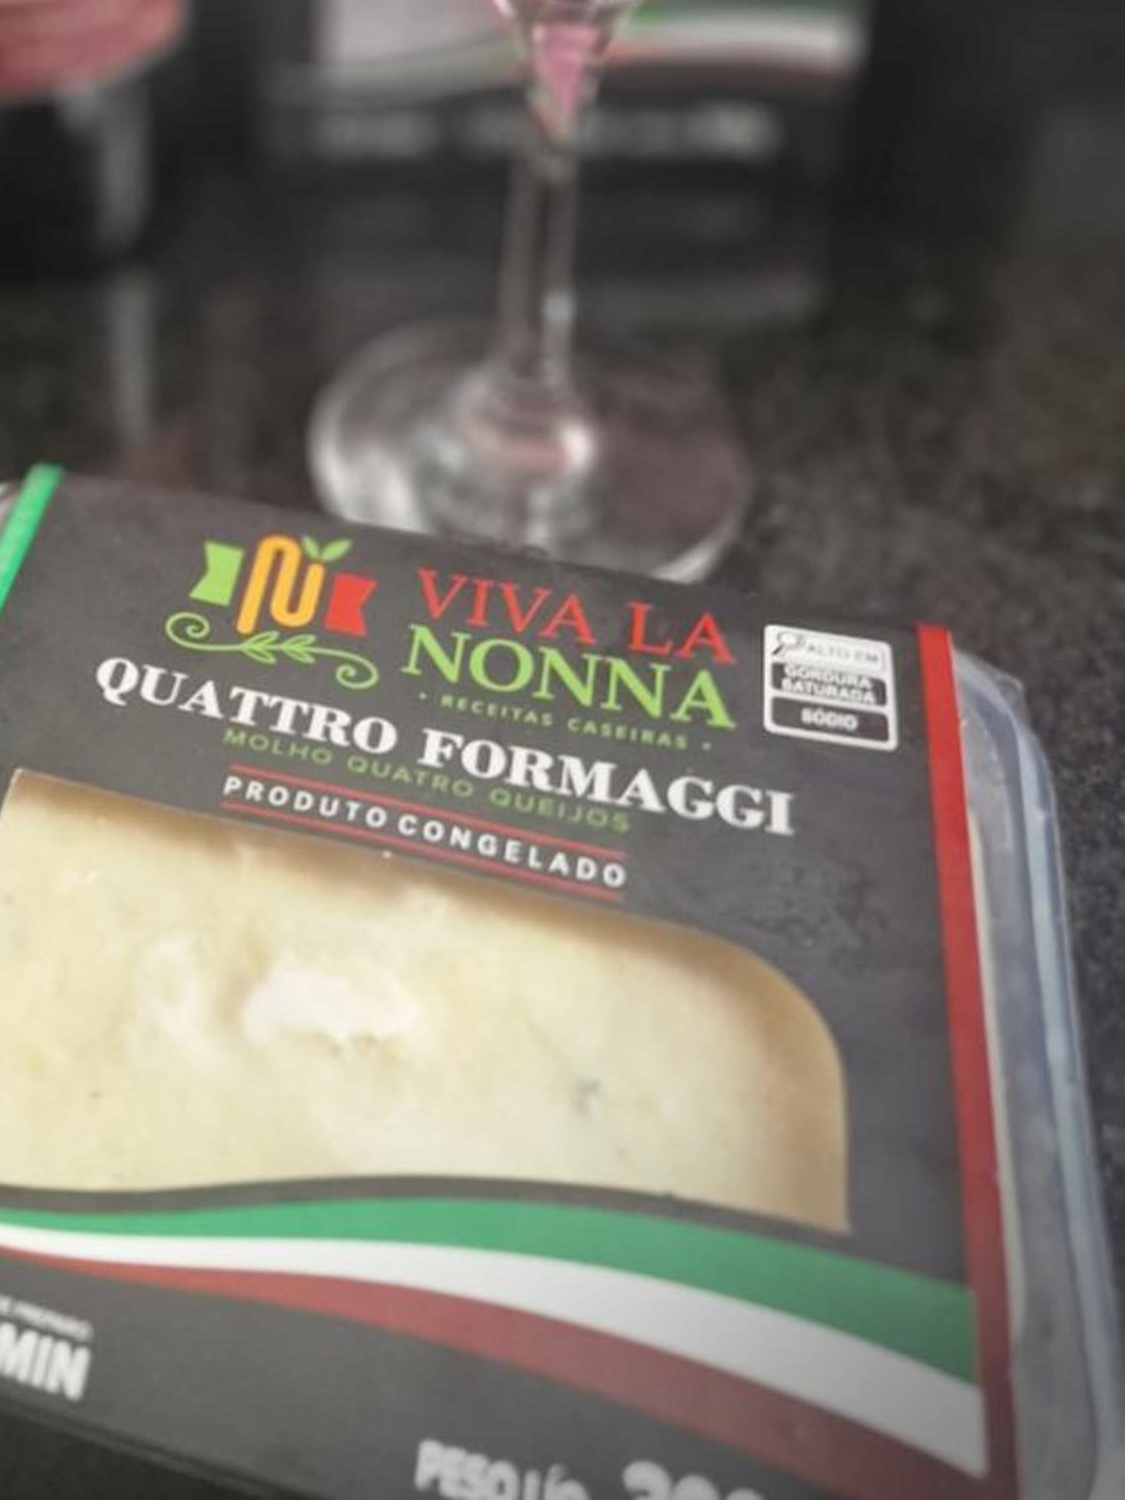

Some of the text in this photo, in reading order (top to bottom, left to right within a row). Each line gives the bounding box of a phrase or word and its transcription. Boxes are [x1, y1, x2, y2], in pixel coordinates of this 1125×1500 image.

[417, 566, 737, 665] VIVA LA
[400, 623, 737, 731] NONNA
[440, 694, 688, 750] RECEITAS CASEIRAS
[96, 657, 795, 837] QUATTRO FORMAGGI
[223, 728, 630, 832] MOLHO QUATRO QUEIJOS
[223, 775, 625, 888] PRODUTO CONGELADO
